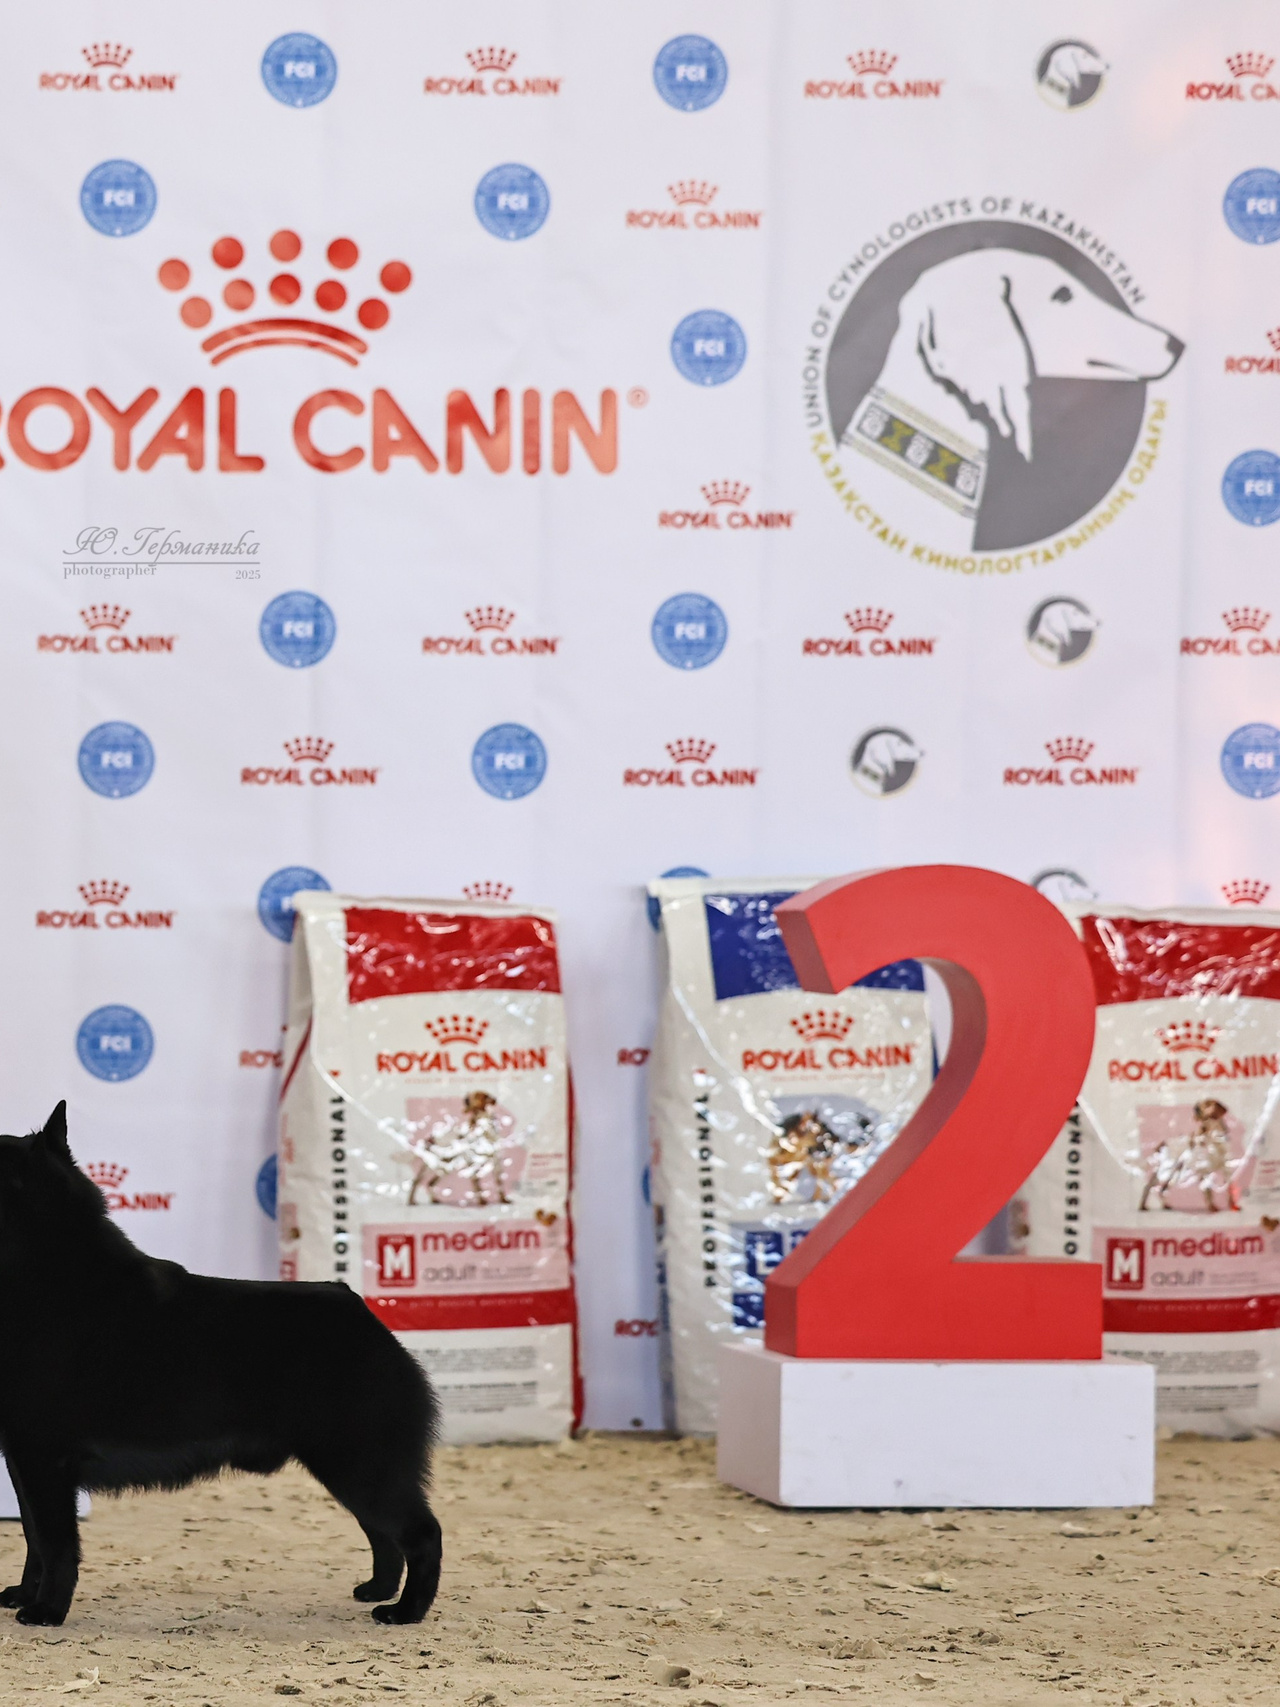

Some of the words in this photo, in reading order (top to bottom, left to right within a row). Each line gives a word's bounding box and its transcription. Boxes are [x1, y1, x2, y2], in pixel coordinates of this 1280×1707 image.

[284, 61, 316, 79] FCI
[676, 64, 707, 82] FCI
[40, 73, 102, 92] ROYAL
[109, 73, 176, 92] CANIN
[425, 78, 486, 96] ROYAL
[493, 78, 560, 96] CANIN
[805, 81, 867, 99] ROYAL
[874, 81, 942, 99] CANIN
[1185, 82, 1247, 101] ROYAL
[1253, 82, 1280, 101] CA
[103, 189, 135, 207] FCI
[497, 192, 529, 211] FCI
[980, 196, 1012, 214] OF
[1246, 197, 1277, 215] FCI
[627, 211, 688, 228] ROYAL
[695, 211, 761, 228] CANIN
[827, 196, 972, 302] CYNOLOGISTS
[1019, 198, 1146, 305] KAZAKHSTAN
[810, 305, 832, 339] OF
[694, 338, 725, 357] FCI
[802, 346, 824, 429] UNION
[1244, 479, 1274, 496] FCI
[659, 511, 720, 529] ROYAL
[727, 511, 793, 529] CANIN
[283, 620, 313, 638] FCI
[674, 622, 706, 640] FCI
[38, 635, 100, 653] ROYAL
[107, 635, 174, 653] CANIN
[422, 637, 484, 655] ROYAL
[491, 637, 558, 655] CANIN
[803, 638, 864, 656] ROYAL
[871, 638, 935, 656] CANIN
[1181, 638, 1242, 656] ROYAL
[101, 751, 132, 768] FCI
[494, 752, 525, 770] FCI
[1244, 751, 1276, 770] FCI
[241, 767, 303, 786] ROYAL
[310, 767, 378, 786] CANIN
[623, 768, 685, 788] ROYAL
[692, 768, 758, 788] CANIN
[1004, 768, 1065, 786] ROYAL
[1071, 768, 1137, 786] CANIN
[36, 910, 98, 929] ROYAL
[106, 910, 173, 929] CANIN
[101, 1035, 131, 1052] FCI
[376, 1052, 457, 1073] ROYAL
[463, 1048, 548, 1071] CANIN
[742, 1049, 822, 1070] ROYAL
[828, 1046, 912, 1068] CANIN
[1108, 1059, 1187, 1081] ROYAL
[1193, 1054, 1279, 1079] CANIN
[765, 865, 1104, 1360] 2
[331, 1095, 350, 1281] ROFESSIONAL
[422, 1225, 541, 1251] medium
[1152, 1234, 1264, 1257] medium
[382, 1244, 413, 1279] M
[1112, 1248, 1141, 1281] M
[1152, 1271, 1204, 1287] adult
